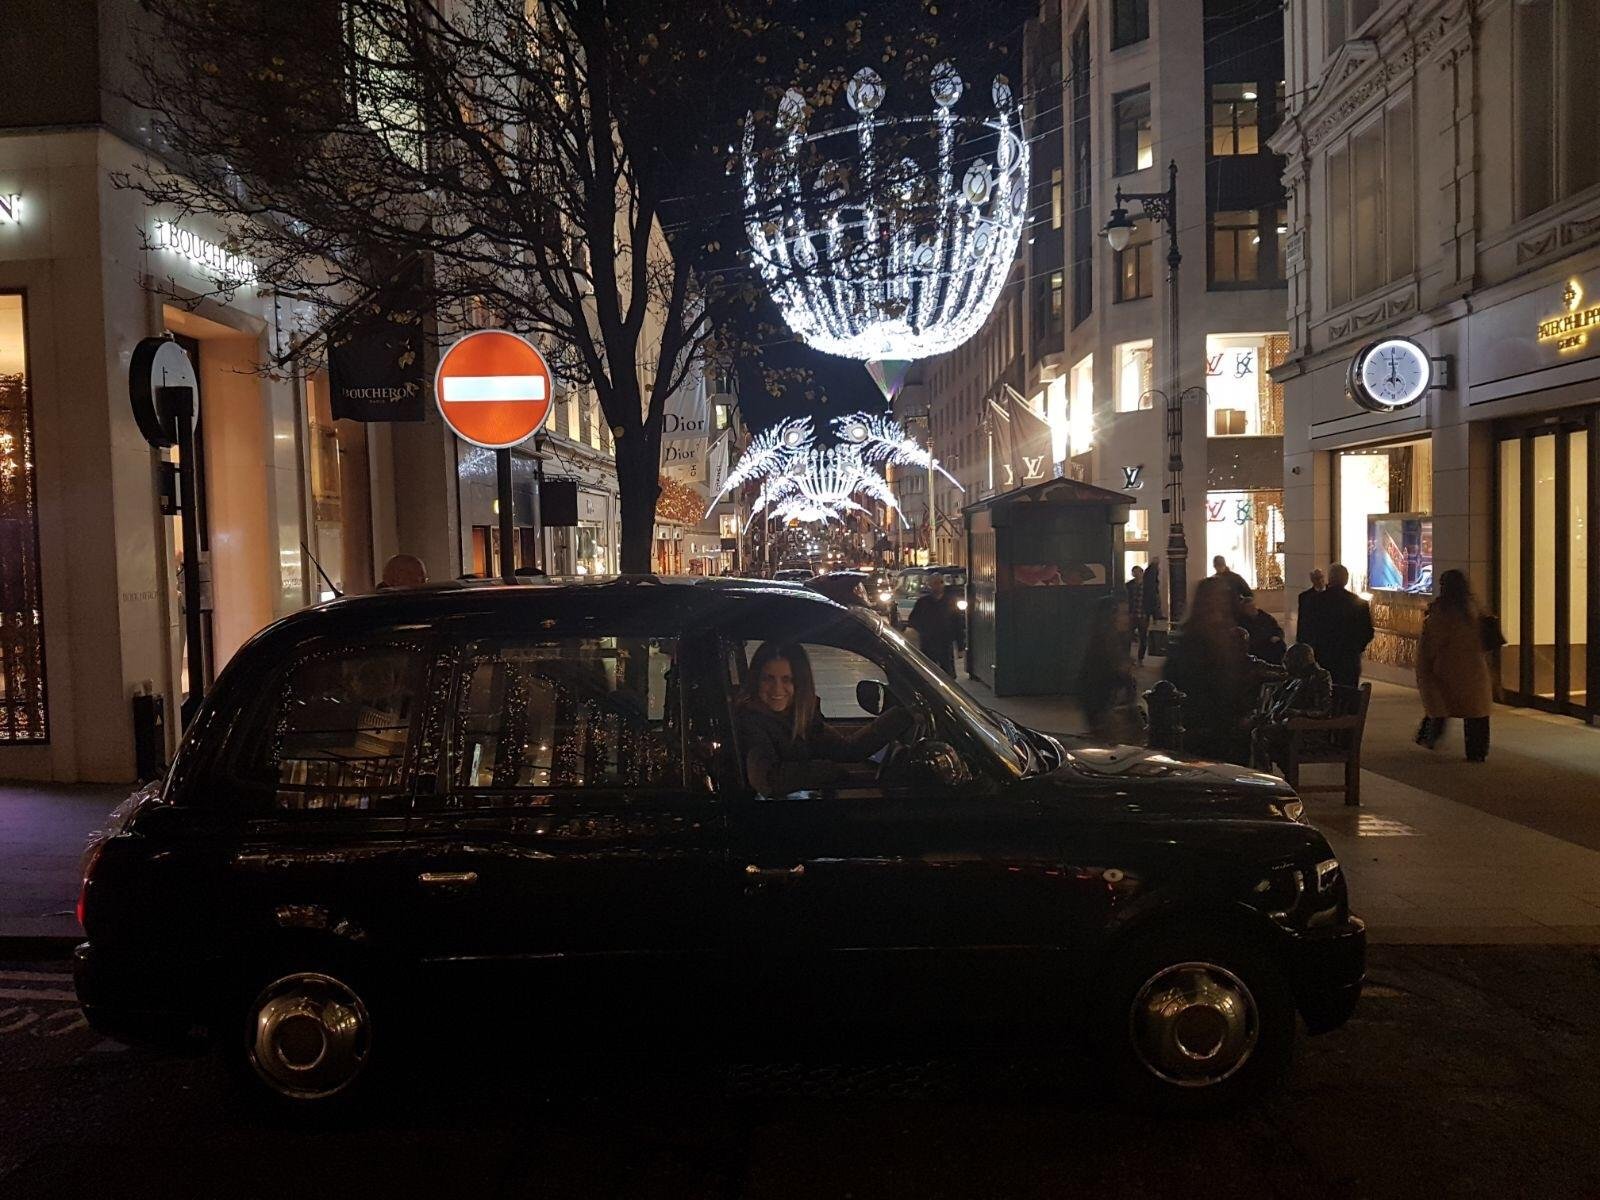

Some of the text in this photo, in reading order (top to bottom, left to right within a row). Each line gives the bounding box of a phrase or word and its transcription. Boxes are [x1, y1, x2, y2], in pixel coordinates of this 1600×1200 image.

[1563, 307, 1600, 332] PHILIPP
[342, 386, 416, 399] BOUCHERON
[662, 413, 705, 434] Dior
[665, 447, 696, 461] Dior
[1022, 455, 1045, 480] LV
[1121, 464, 1144, 491] LV
